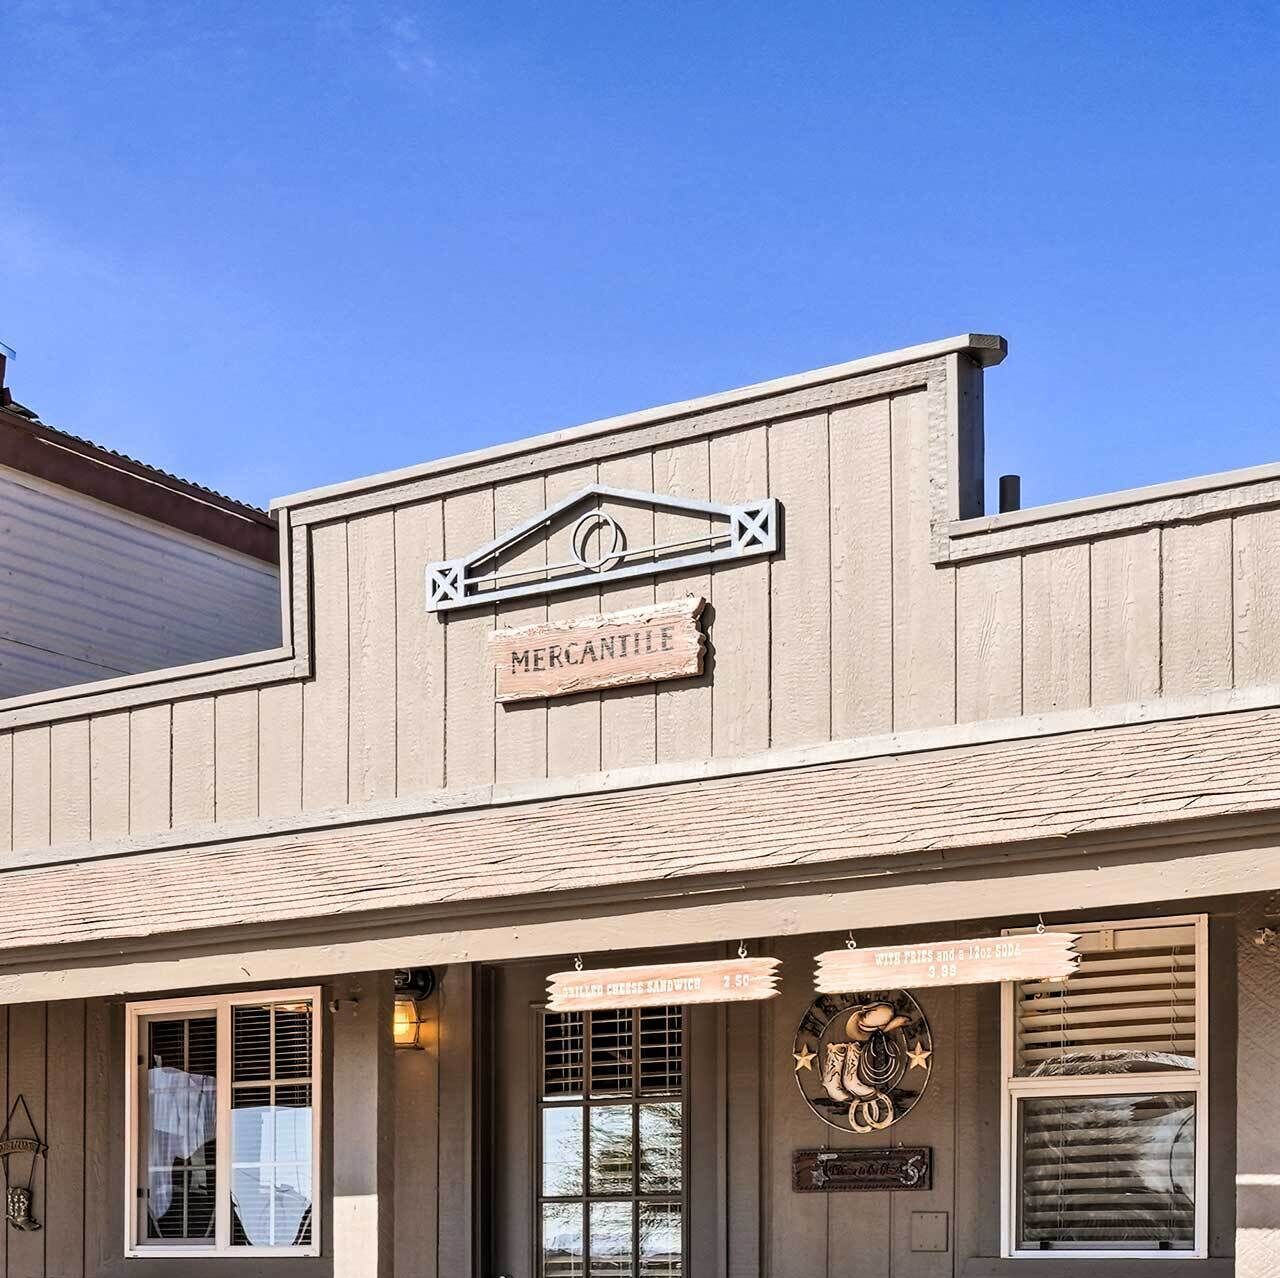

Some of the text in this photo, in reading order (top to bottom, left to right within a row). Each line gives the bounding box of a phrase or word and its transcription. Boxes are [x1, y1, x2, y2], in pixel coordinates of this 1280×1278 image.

[510, 626, 675, 675] MERCANTILE
[875, 943, 1022, 967] WITH FRIES and a 12oz SODA
[606, 981, 644, 996] CHEESE
[646, 977, 702, 994] SANDWICH
